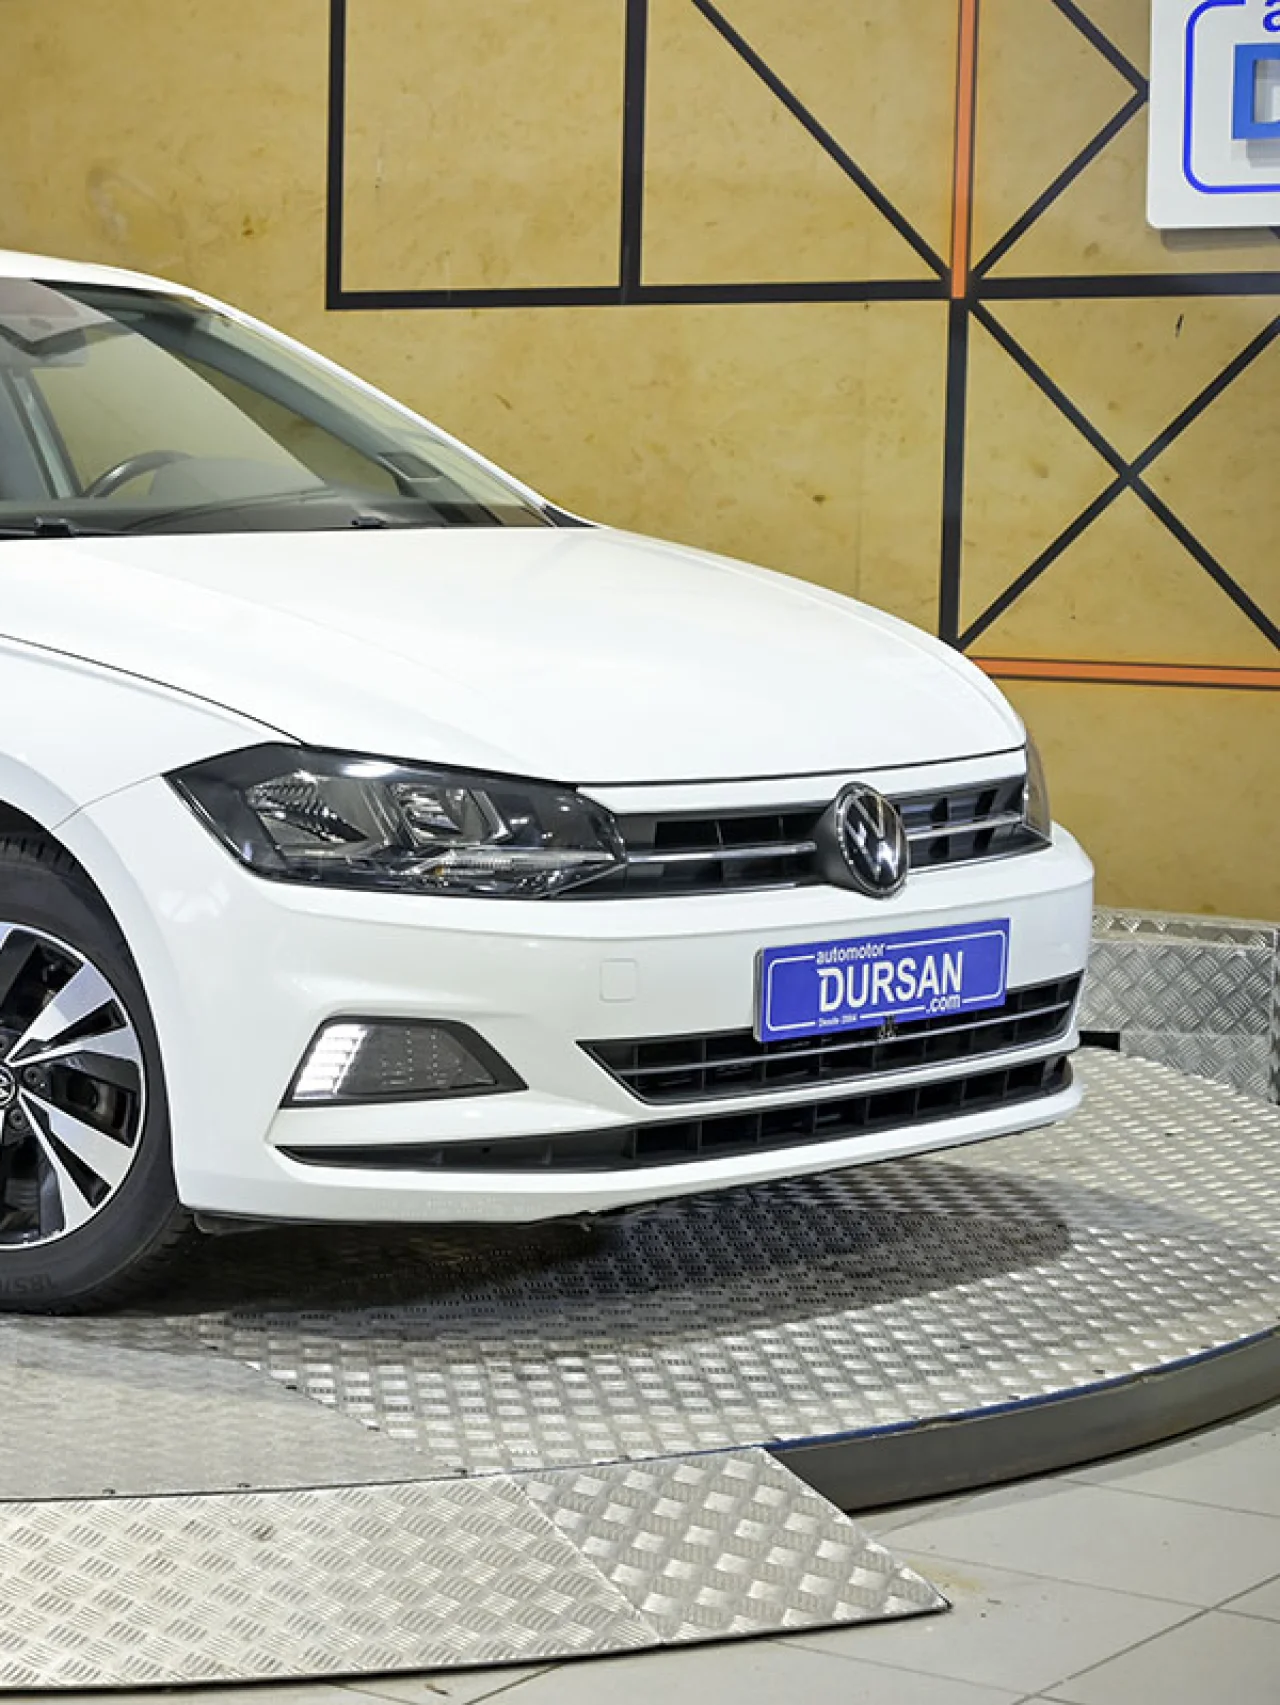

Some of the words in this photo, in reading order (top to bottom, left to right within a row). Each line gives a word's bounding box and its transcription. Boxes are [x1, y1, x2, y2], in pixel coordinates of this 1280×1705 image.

[816, 942, 885, 965] automotor
[816, 951, 964, 1013] DURSAN
[925, 994, 961, 1014] .com
